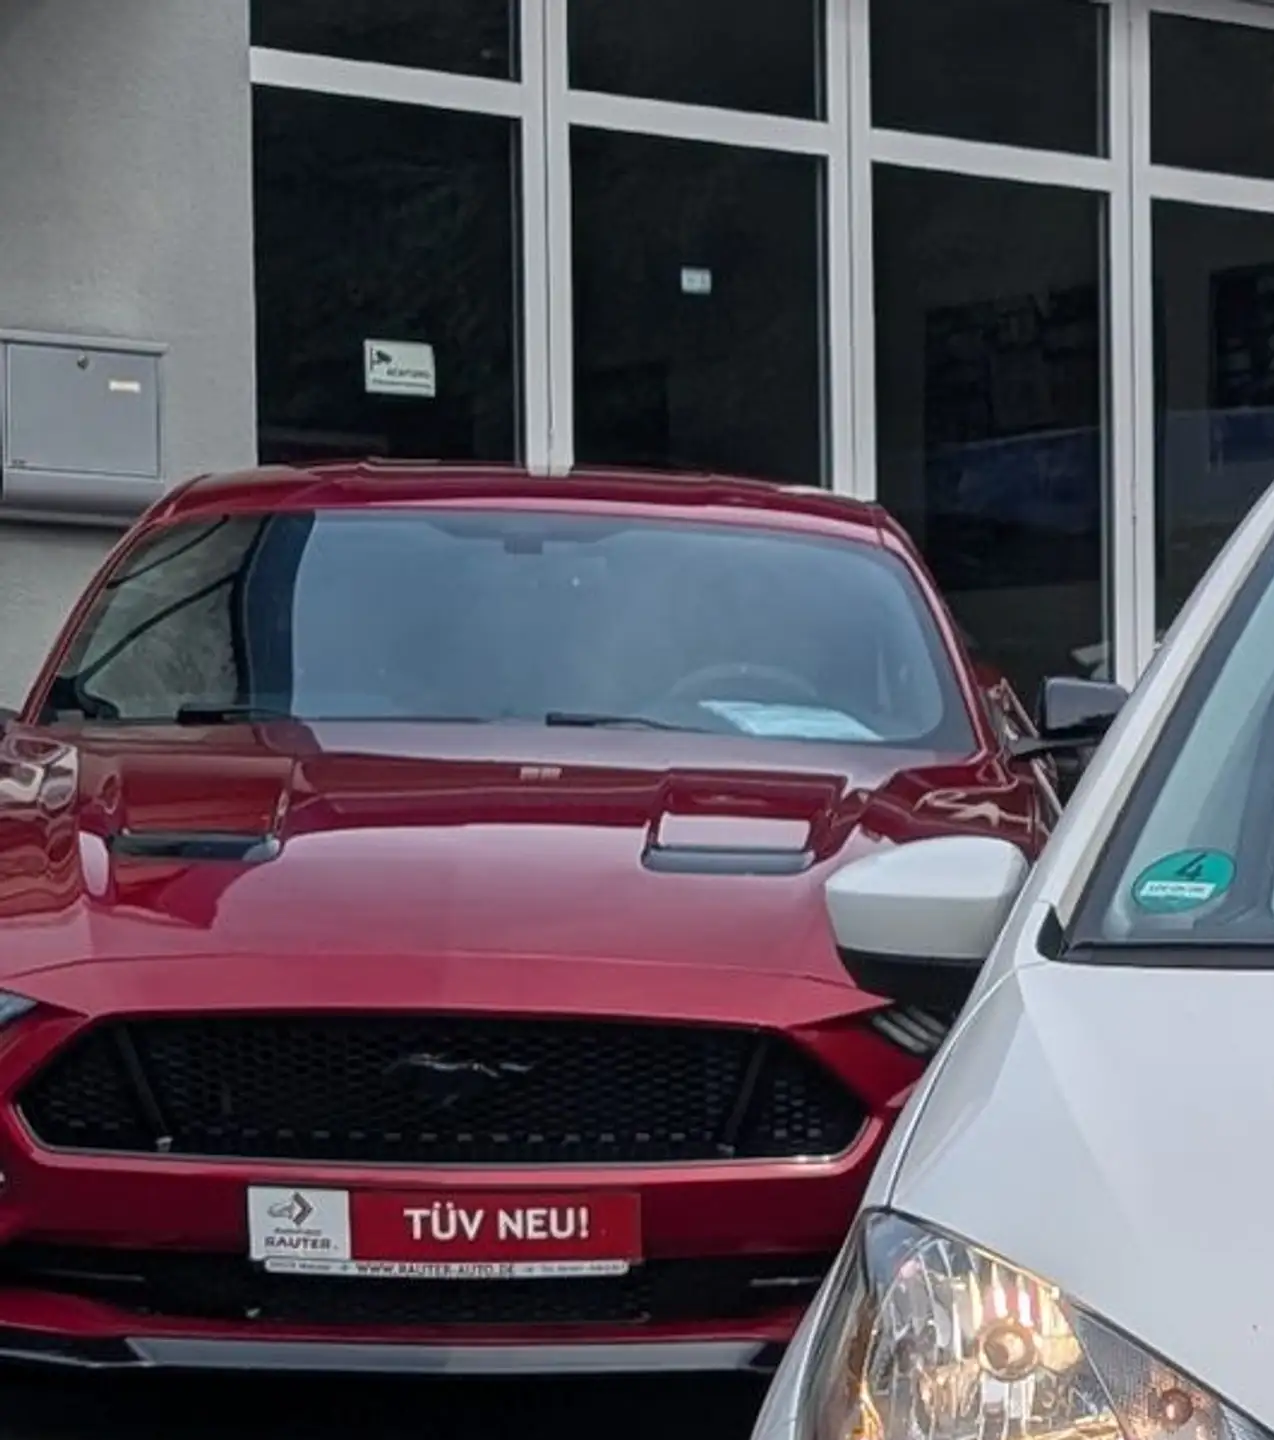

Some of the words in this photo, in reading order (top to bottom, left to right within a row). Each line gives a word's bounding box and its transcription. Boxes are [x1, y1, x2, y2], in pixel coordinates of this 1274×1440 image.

[1175, 852, 1208, 881] 4
[404, 1201, 485, 1241] TÜV
[497, 1206, 590, 1240] NEU!
